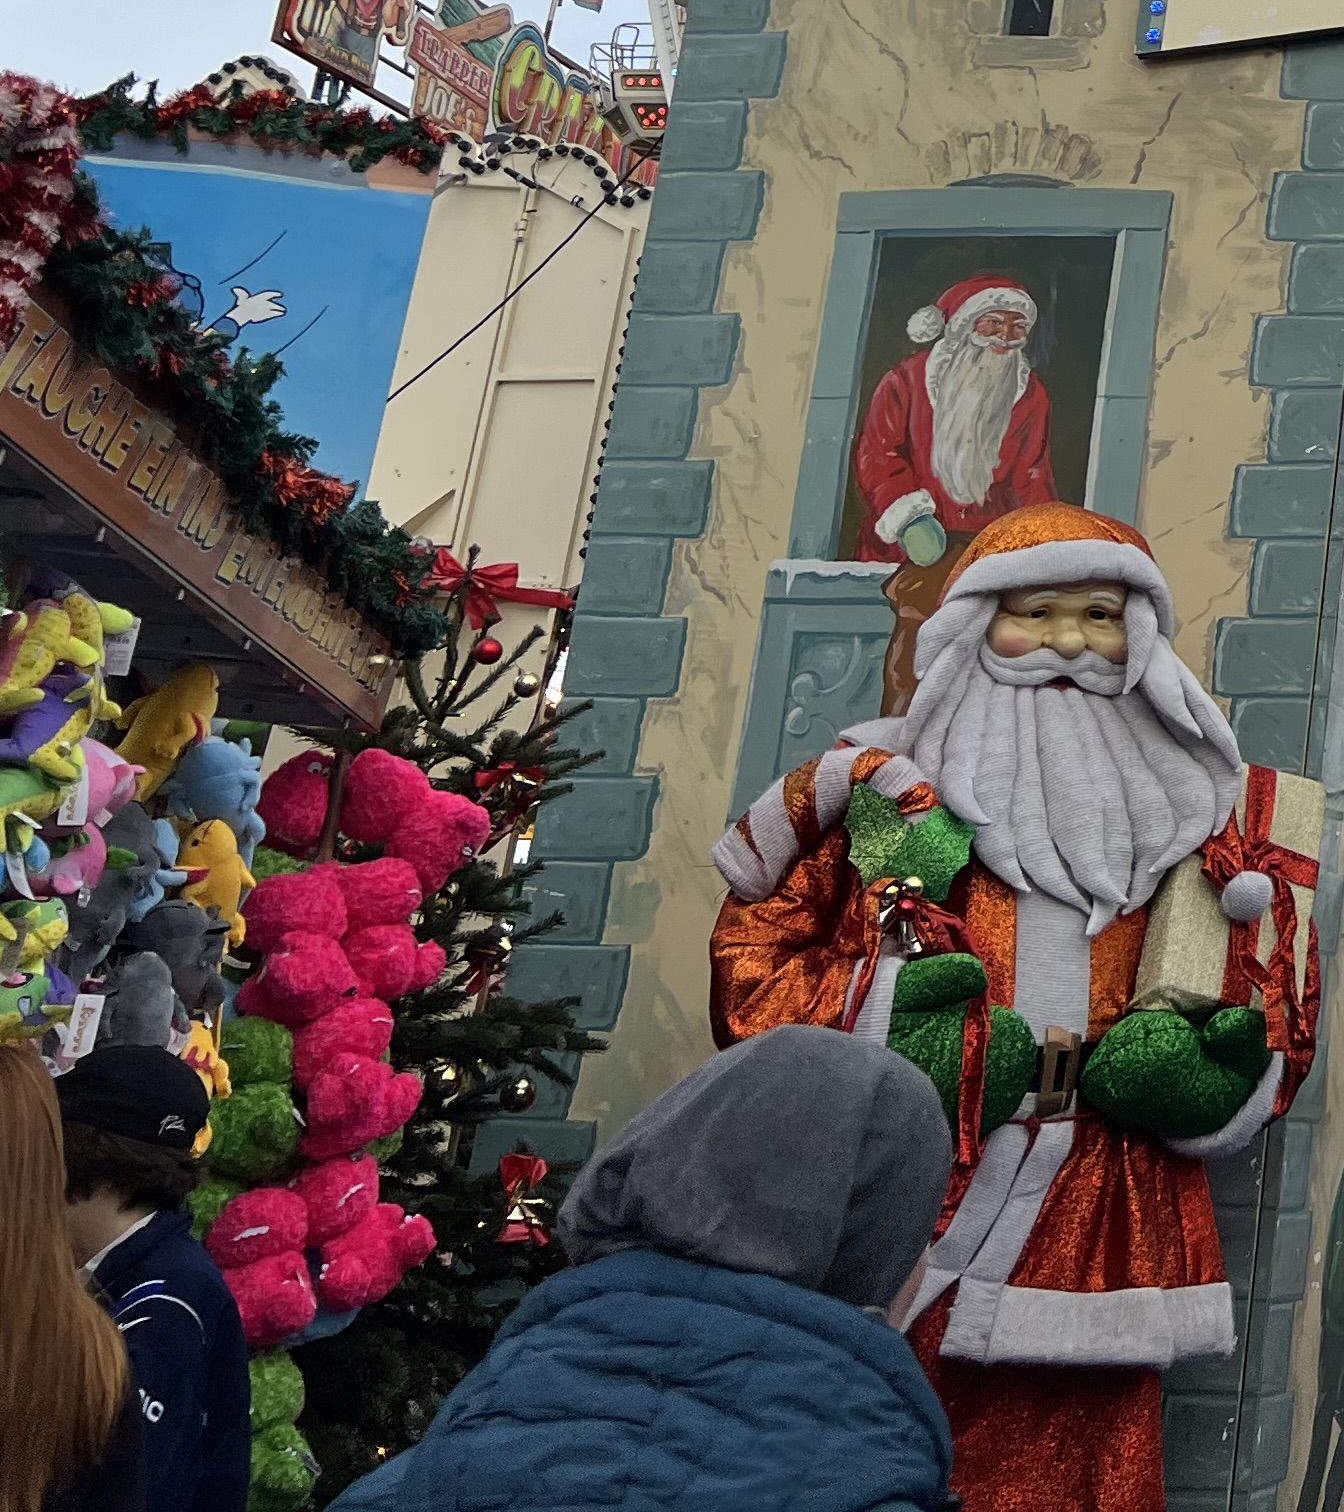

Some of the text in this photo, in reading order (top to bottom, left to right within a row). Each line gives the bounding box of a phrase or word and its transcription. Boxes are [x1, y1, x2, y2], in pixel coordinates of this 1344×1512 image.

[420, 78, 478, 133] JOE'S
[0, 302, 151, 475] TAUCHE
[126, 420, 196, 517] EIN
[177, 465, 240, 553] INS
